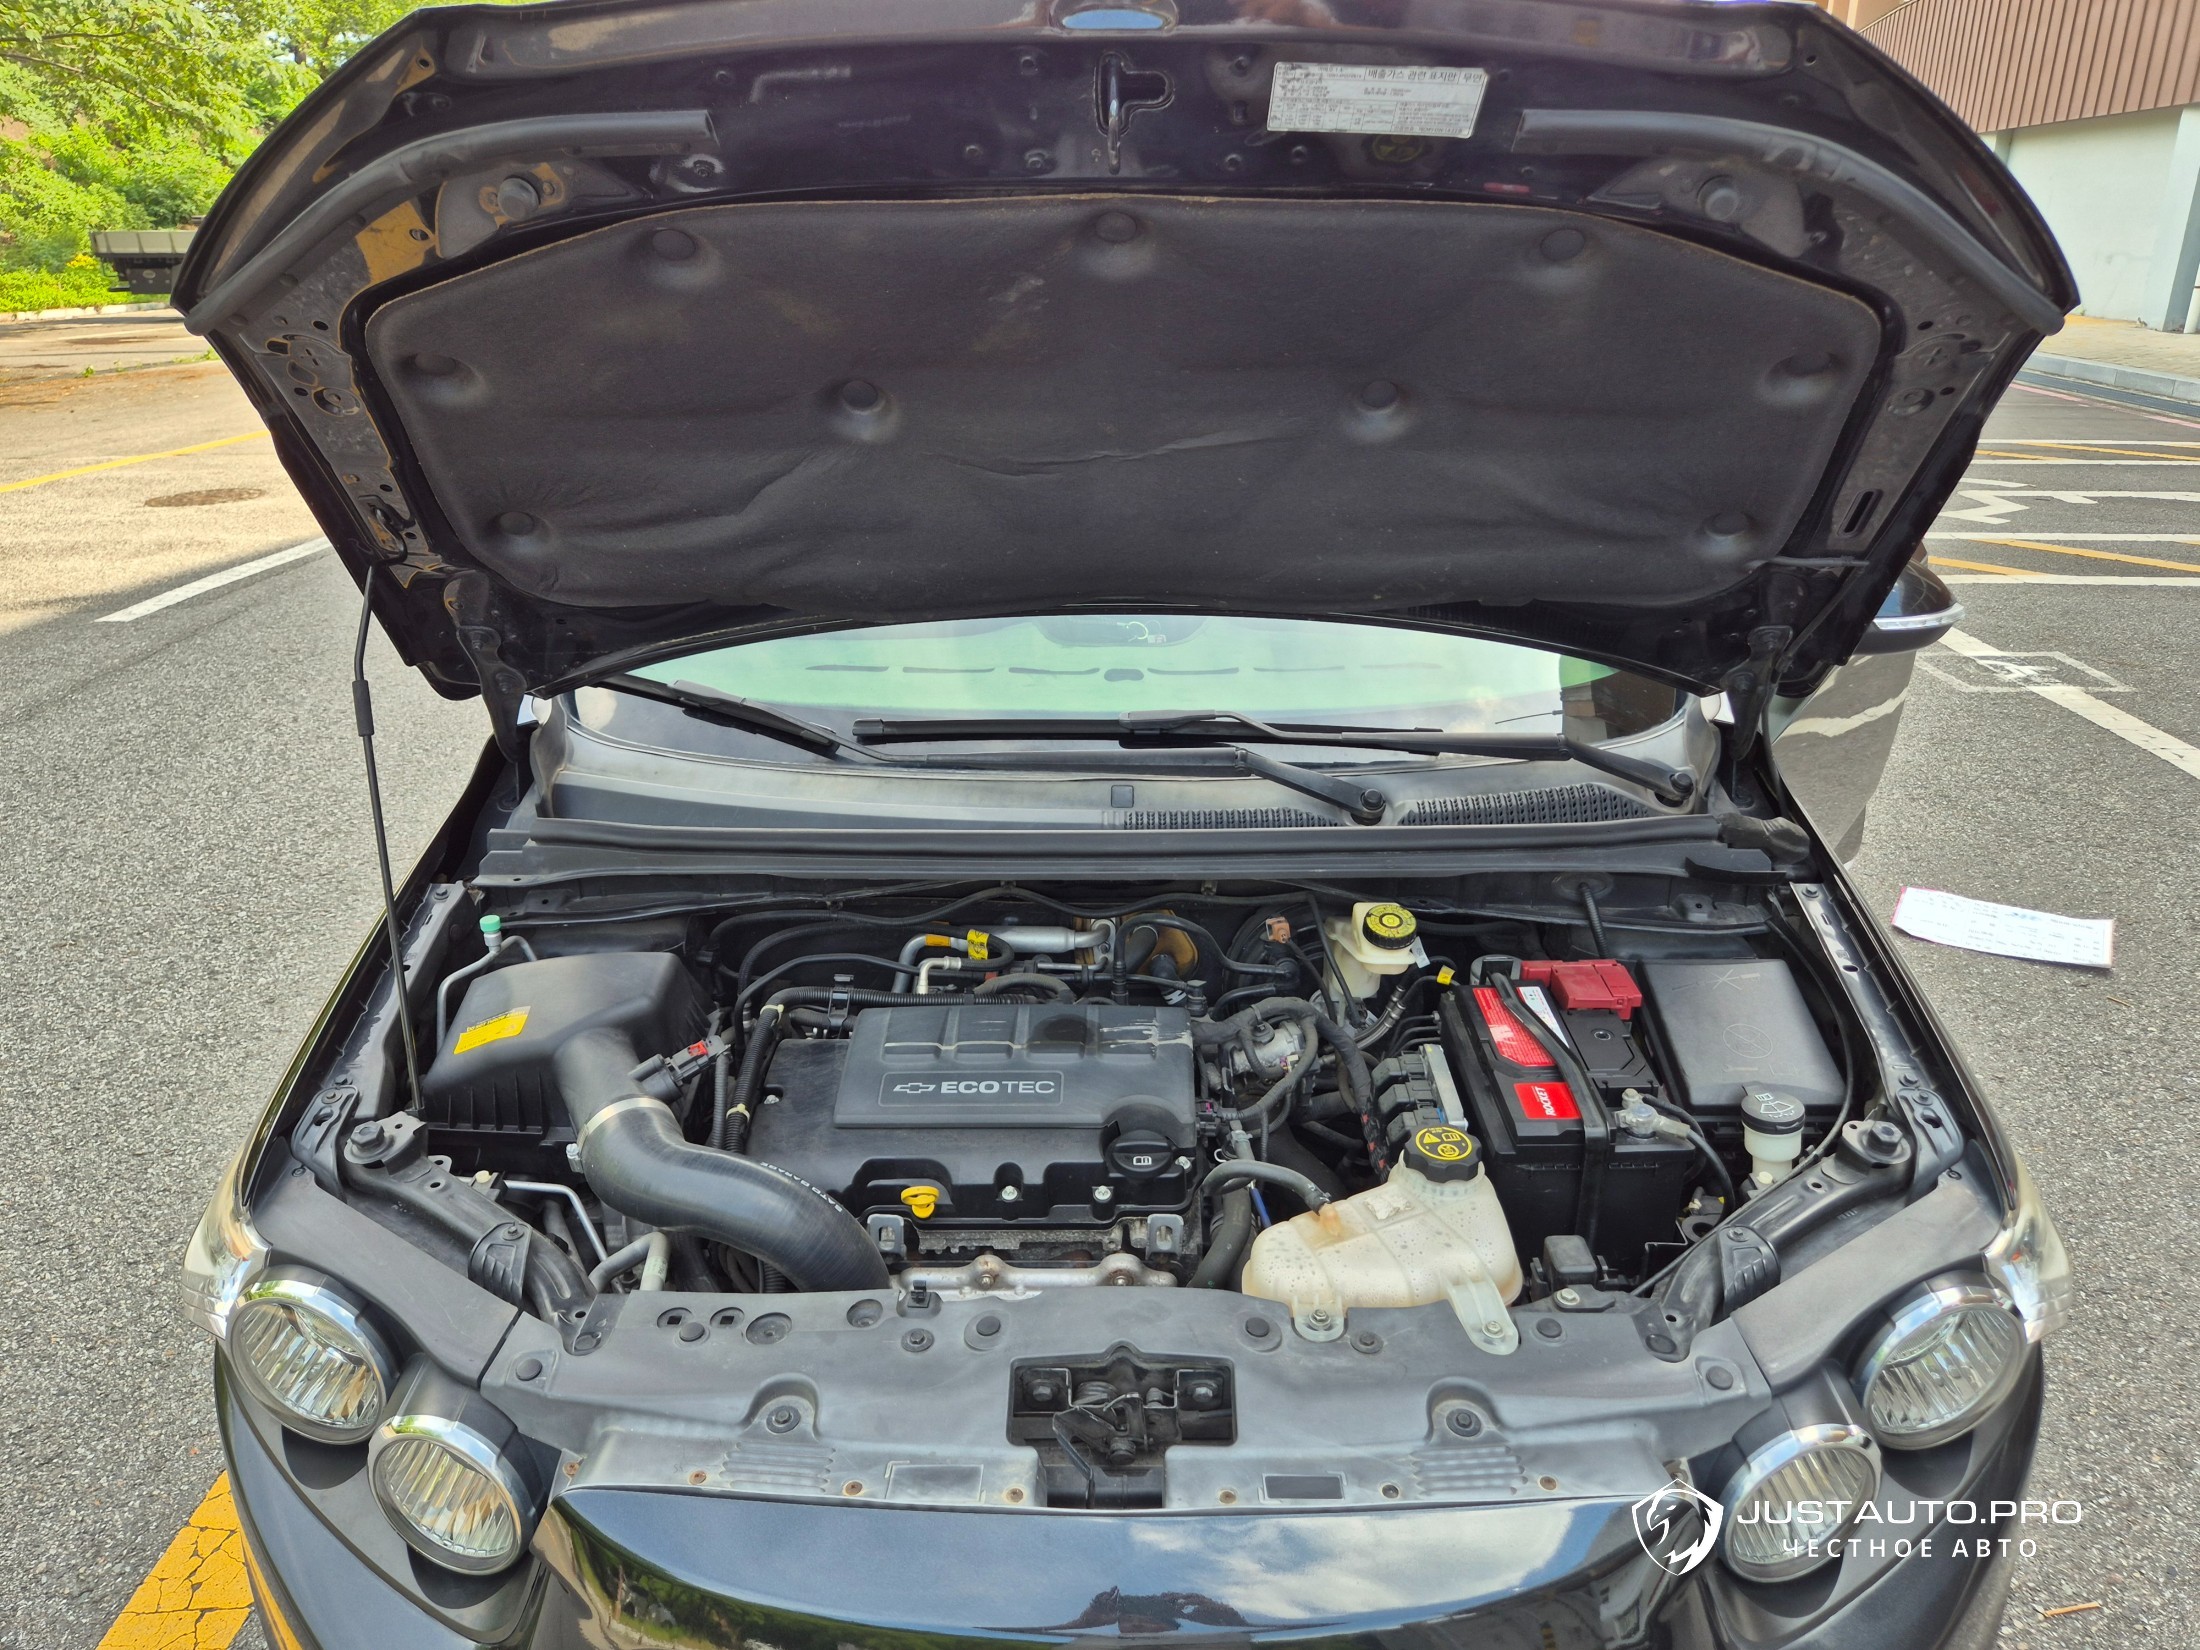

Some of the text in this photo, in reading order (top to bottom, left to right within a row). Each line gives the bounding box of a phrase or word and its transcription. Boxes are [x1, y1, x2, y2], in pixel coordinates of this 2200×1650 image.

[940, 1080, 1055, 1094] ECOTEC
[1534, 1086, 1557, 1116] ROCKET
[759, 1161, 843, 1213] SATO GARAGE
